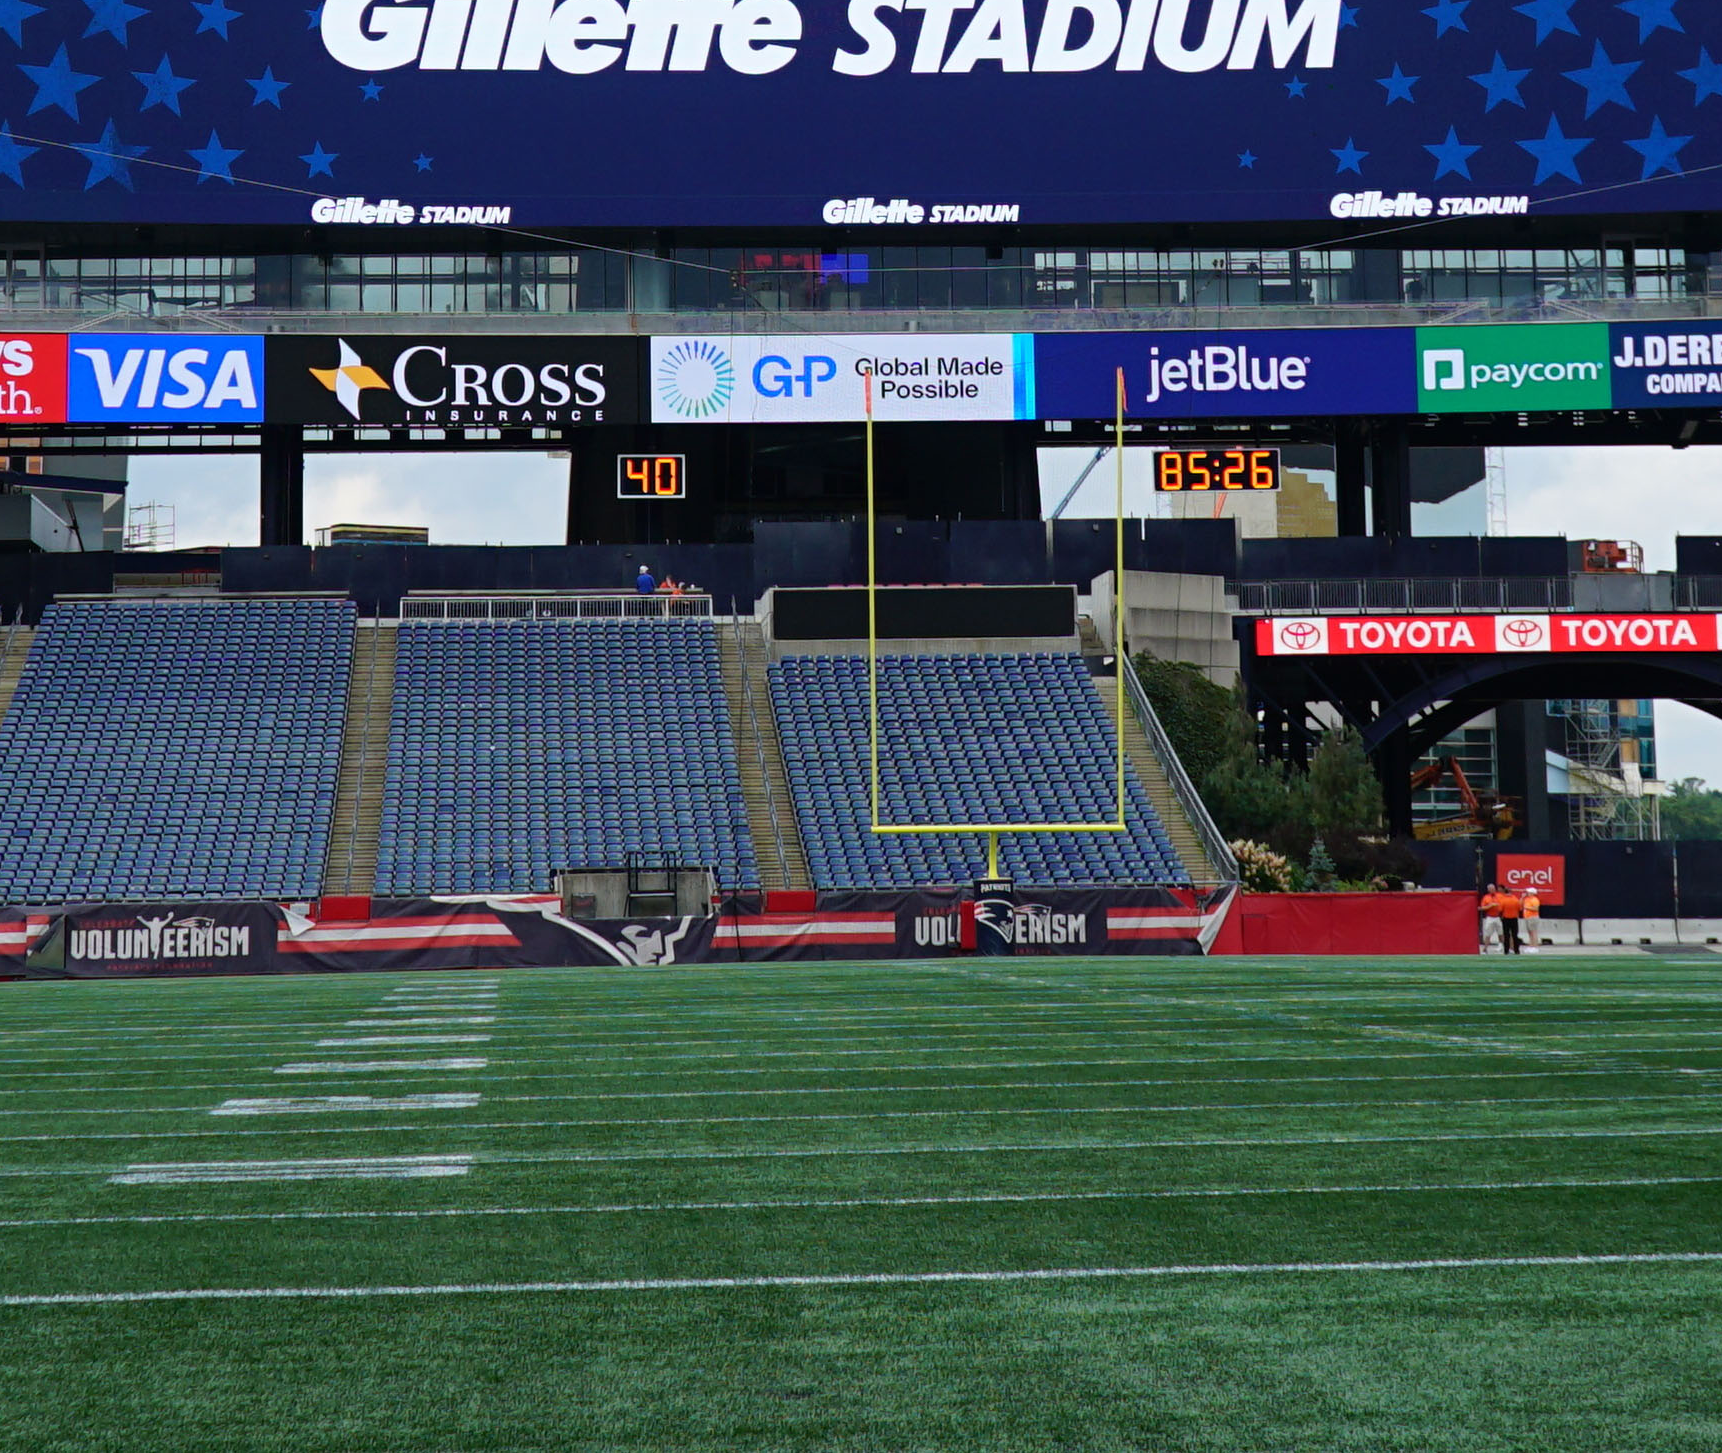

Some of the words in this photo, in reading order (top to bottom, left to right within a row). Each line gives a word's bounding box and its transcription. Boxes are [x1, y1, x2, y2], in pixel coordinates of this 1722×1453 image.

[312, 197, 415, 224] Gillette
[420, 206, 510, 224] STADIUM
[823, 198, 924, 224] Gillette
[929, 205, 1019, 223] STADIUM
[1330, 191, 1432, 218] Gillette
[1437, 196, 1528, 215] STADIUM
[75, 349, 257, 408] VISA
[393, 346, 605, 406] CROSS
[753, 355, 836, 397] GP
[855, 358, 928, 376] Global
[938, 357, 1002, 375] Made
[1147, 346, 1307, 402] jetBlue
[1471, 362, 1597, 389] paycom
[882, 380, 978, 398] Possible
[407, 410, 603, 421] INSURANCE
[627, 457, 677, 496] 40
[1160, 450, 1273, 491] 85:26
[1339, 621, 1475, 648] TOYOTA
[1562, 619, 1697, 646] TOYOTA
[1508, 866, 1551, 884] enel
